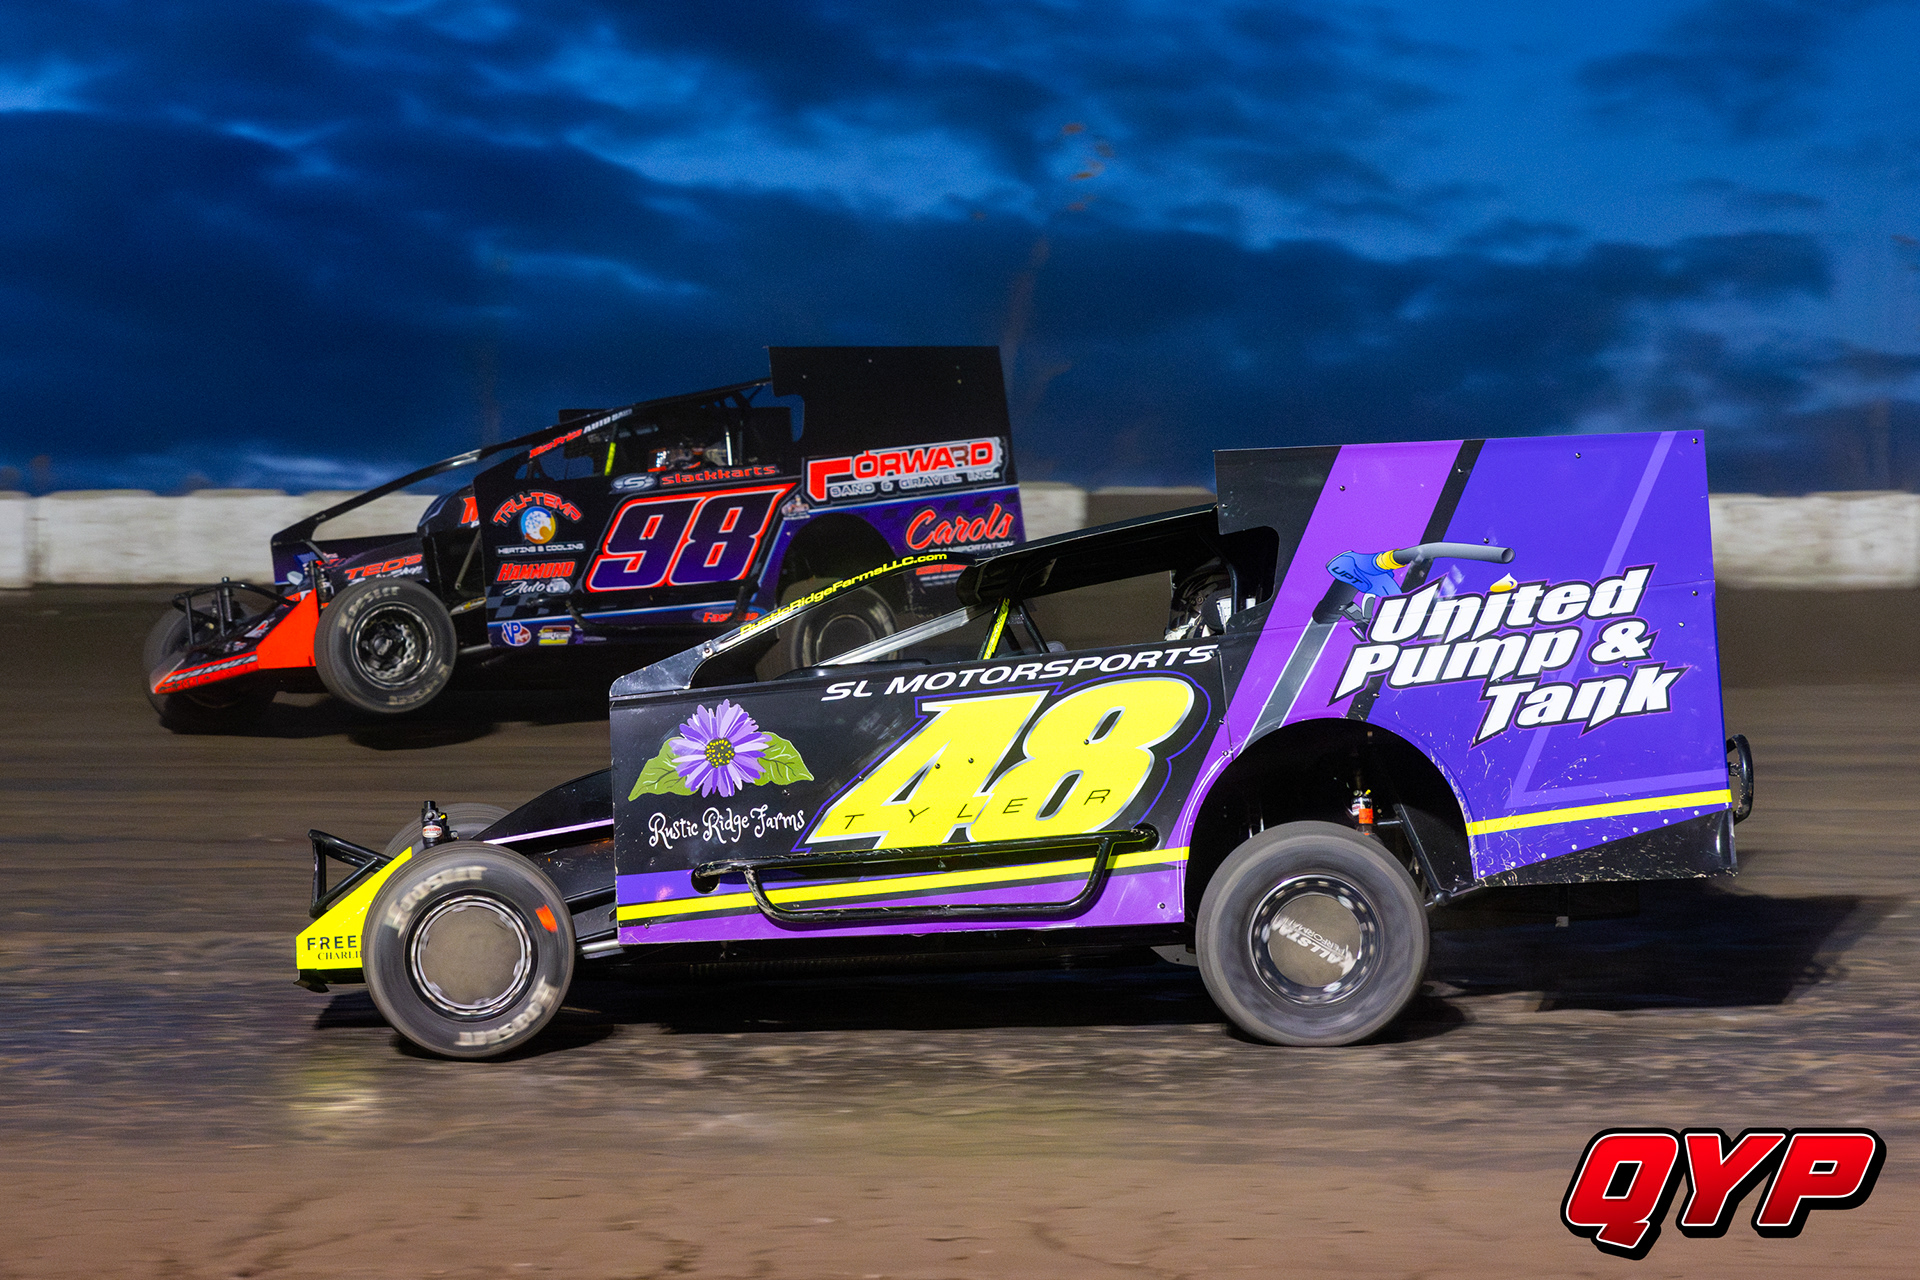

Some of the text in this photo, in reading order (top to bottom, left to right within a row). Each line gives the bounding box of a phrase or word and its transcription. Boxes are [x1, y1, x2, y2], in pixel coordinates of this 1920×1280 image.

[583, 416, 611, 434] AUTO
[808, 441, 993, 501] FORWARD
[829, 482, 875, 498] SAND
[881, 479, 893, 492] &
[900, 472, 962, 488] GRAVEL
[493, 492, 582, 523] TRU-TEMP
[906, 503, 1014, 550] Carols
[545, 543, 584, 552] COOLING
[586, 482, 796, 593] 98
[497, 561, 575, 581] HAMMOND
[502, 580, 545, 596] Auto
[1332, 566, 1364, 584] UPT
[740, 553, 947, 636] RusticRidgeFarmsLLC.com
[1369, 566, 1654, 644] United
[821, 645, 1219, 702] SL MOTORSPORTS
[1334, 619, 1654, 702] Pump &
[1476, 664, 1686, 742] Tank
[805, 677, 1195, 850] 48
[648, 804, 805, 850] Rustic Ridge Farms
[845, 789, 1110, 830] TYLER
[307, 935, 357, 950] FREE
